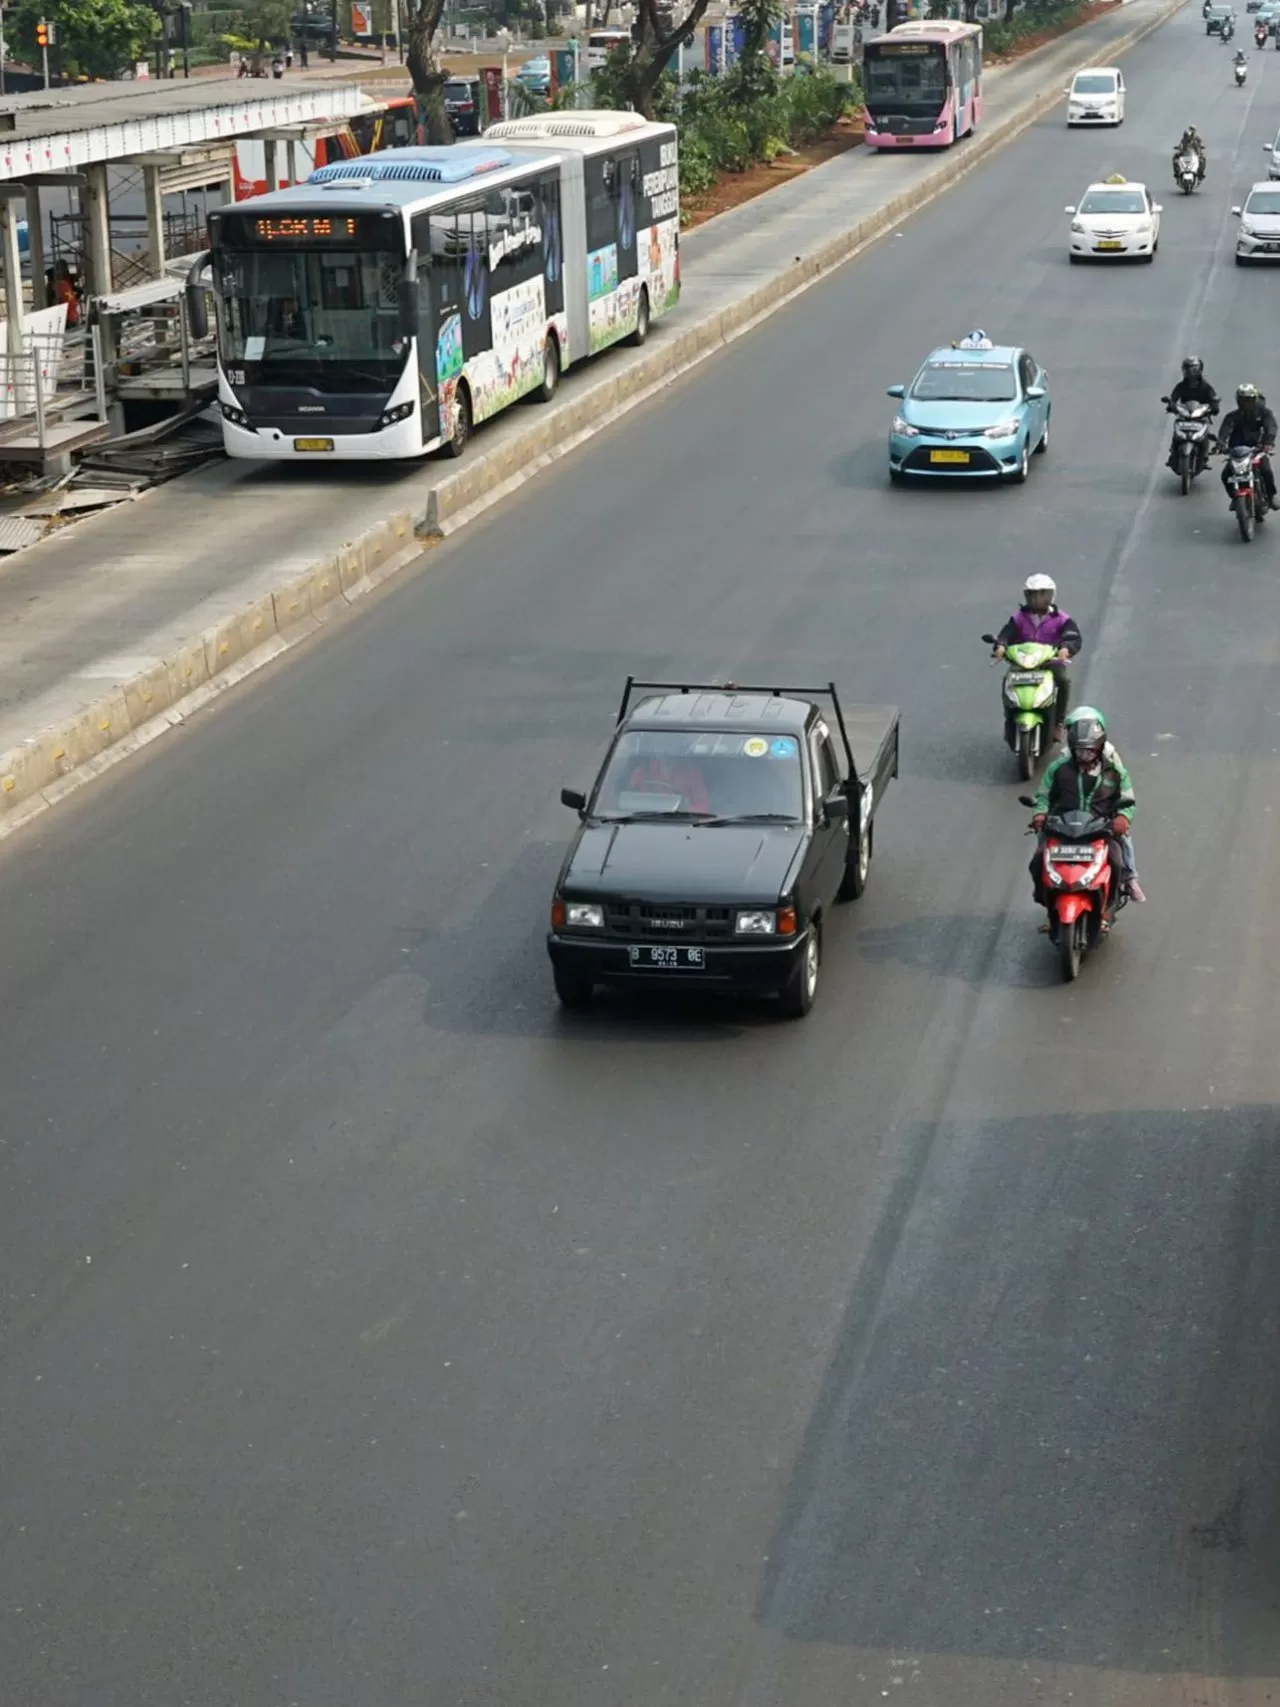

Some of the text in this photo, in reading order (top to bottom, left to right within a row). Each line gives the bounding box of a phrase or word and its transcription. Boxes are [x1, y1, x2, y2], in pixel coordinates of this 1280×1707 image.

[651, 920, 684, 928] ISUZU
[631, 947, 640, 960] B
[651, 948, 677, 961] 9573
